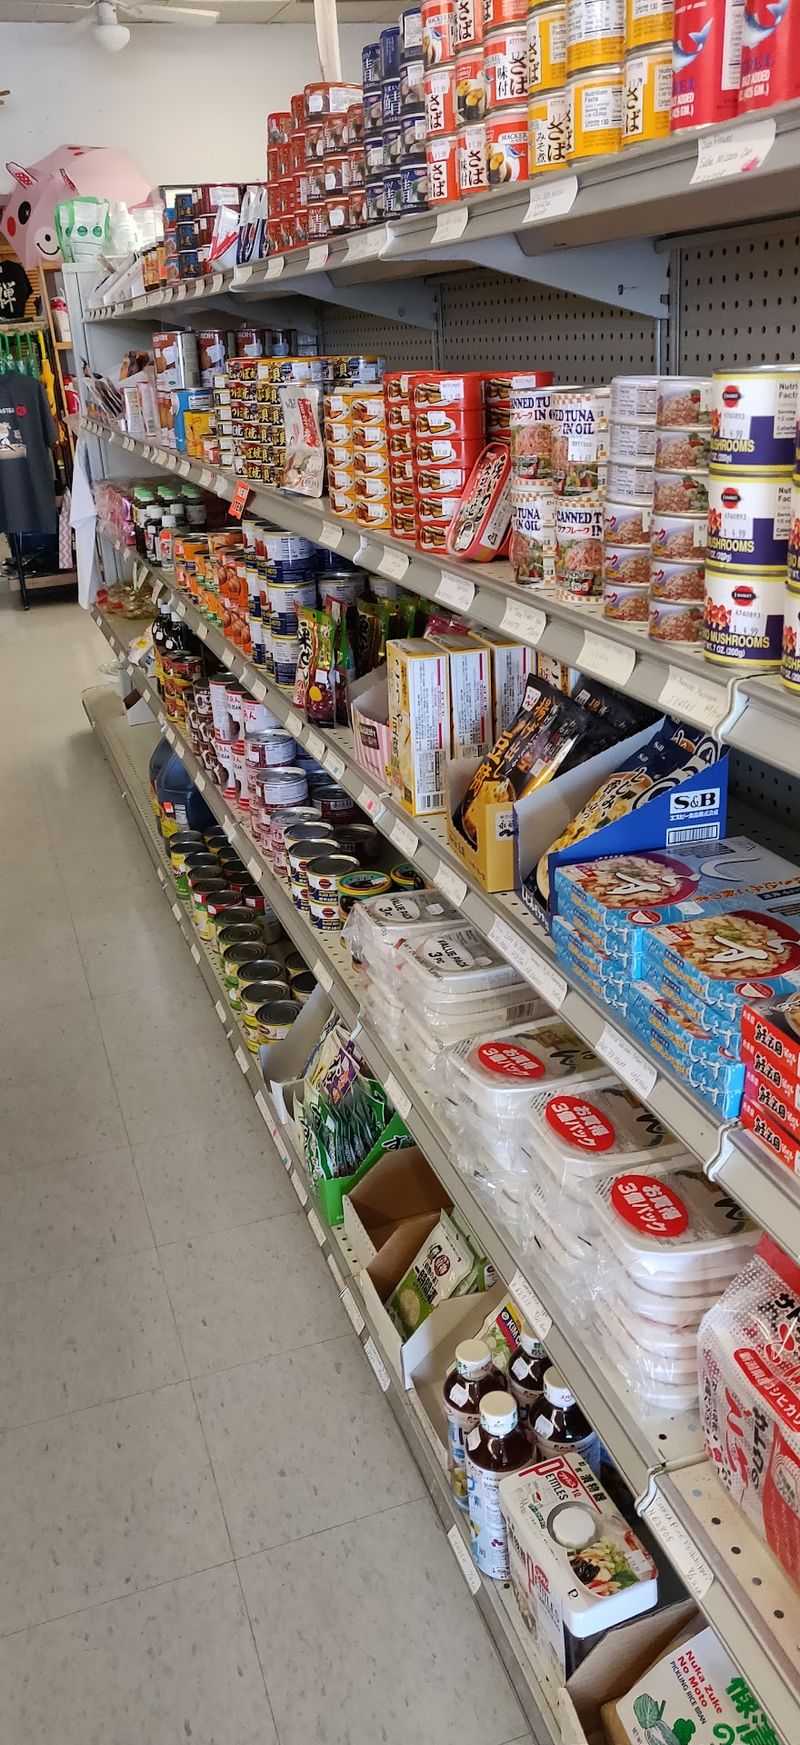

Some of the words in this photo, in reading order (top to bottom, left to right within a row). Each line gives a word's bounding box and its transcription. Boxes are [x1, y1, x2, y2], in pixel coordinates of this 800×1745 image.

[624, 87, 641, 133] さば
[548, 117, 567, 161] さば
[431, 164, 445, 198] さば
[468, 150, 485, 186] さば
[563, 423, 574, 434] IN
[575, 423, 594, 434] OIL
[564, 410, 595, 422] TUNA
[517, 507, 540, 520] TUNA
[524, 520, 540, 531] OIL
[556, 510, 592, 524] CANNED
[710, 630, 770, 649] MUSHROOMS
[674, 792, 716, 810] S&B
[437, 939, 457, 957] VALUE
[551, 1102, 597, 1147] 3個パック
[573, 1105, 610, 1137] お買得
[618, 1182, 667, 1232] 3個パック
[642, 1184, 682, 1221] お買得
[670, 1661, 688, 1692] PICKLING
[686, 1691, 696, 1707] RICE
[694, 1706, 708, 1725] BRAN
[677, 1656, 689, 1674] No
[689, 1676, 708, 1708] Moto
[685, 1649, 705, 1683] Nuka
[704, 1684, 722, 1714] Zuke
